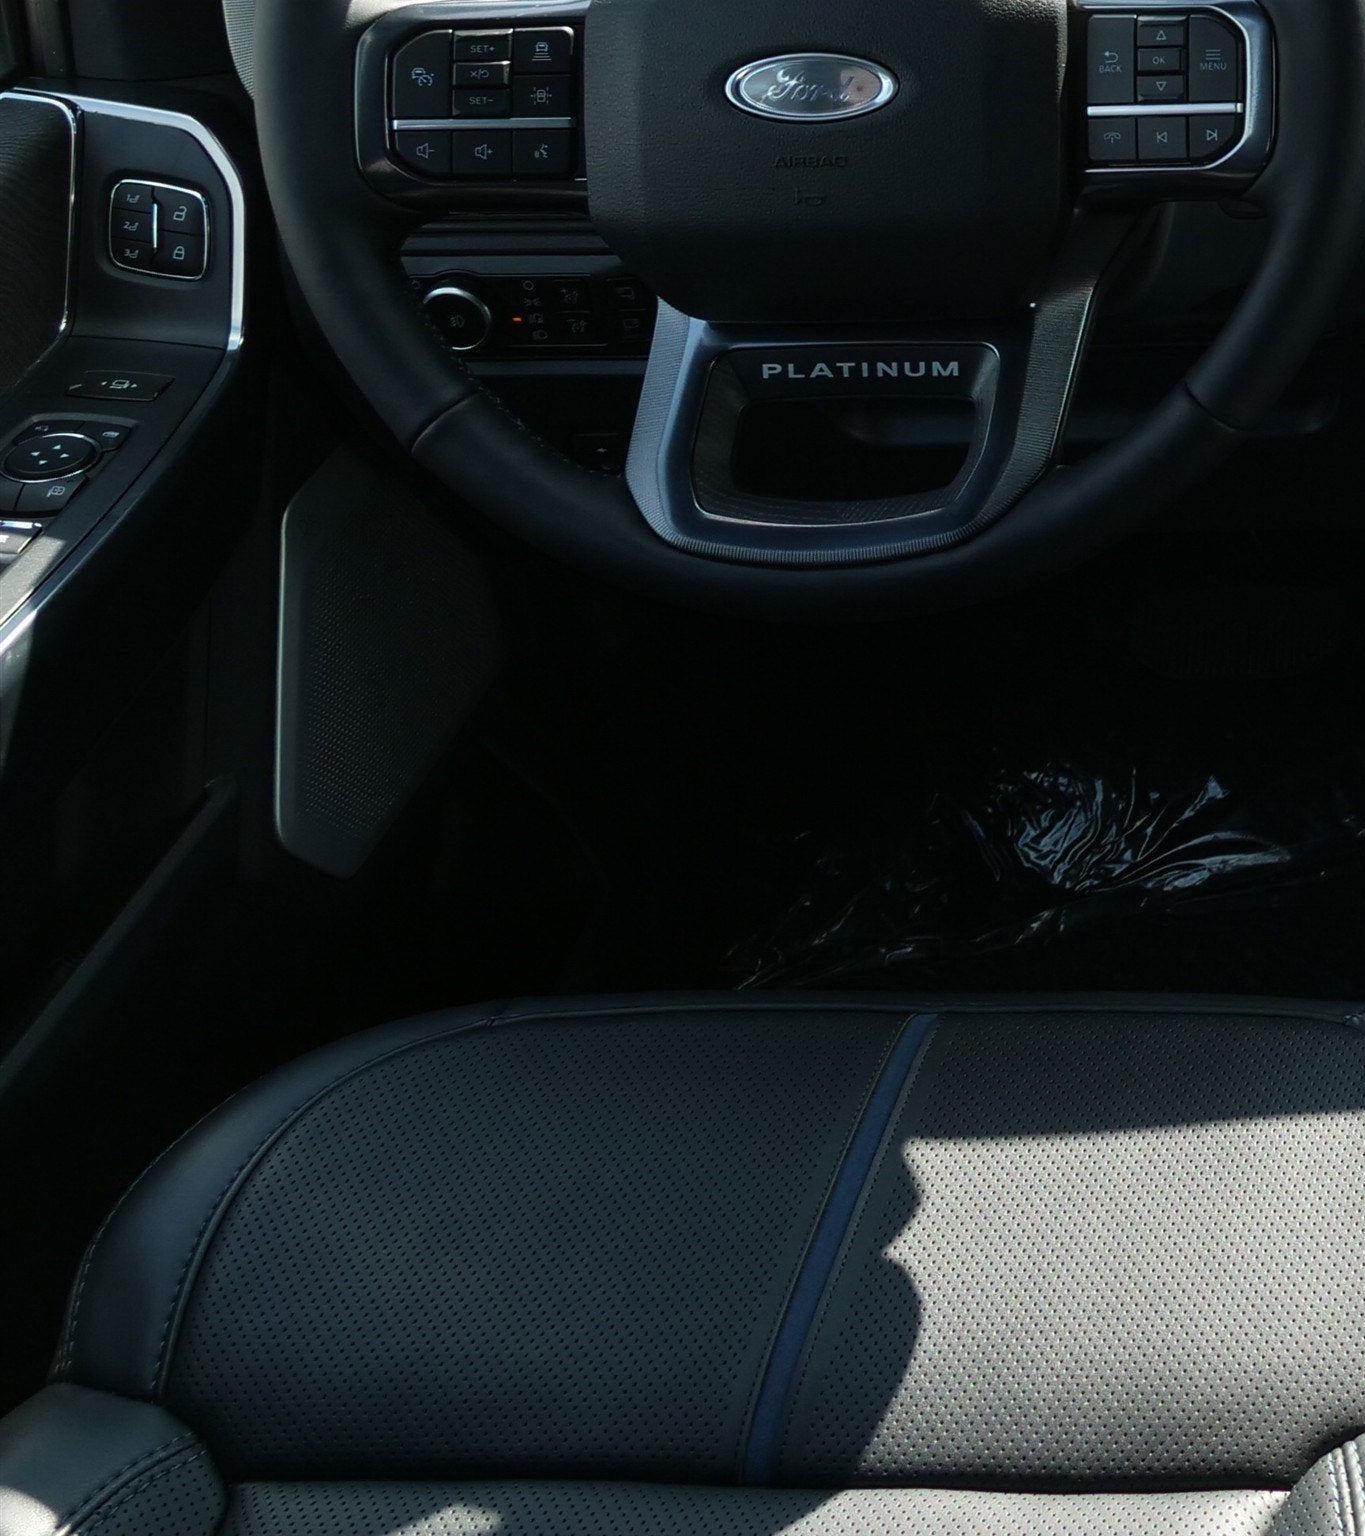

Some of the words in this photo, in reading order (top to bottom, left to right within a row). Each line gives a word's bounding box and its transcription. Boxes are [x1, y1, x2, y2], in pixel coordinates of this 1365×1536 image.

[1152, 56, 1166, 65] OK
[1099, 64, 1123, 73] BACK
[1200, 63, 1227, 71] MENU
[763, 68, 855, 102] Ford
[761, 360, 960, 380] PLATINUM
